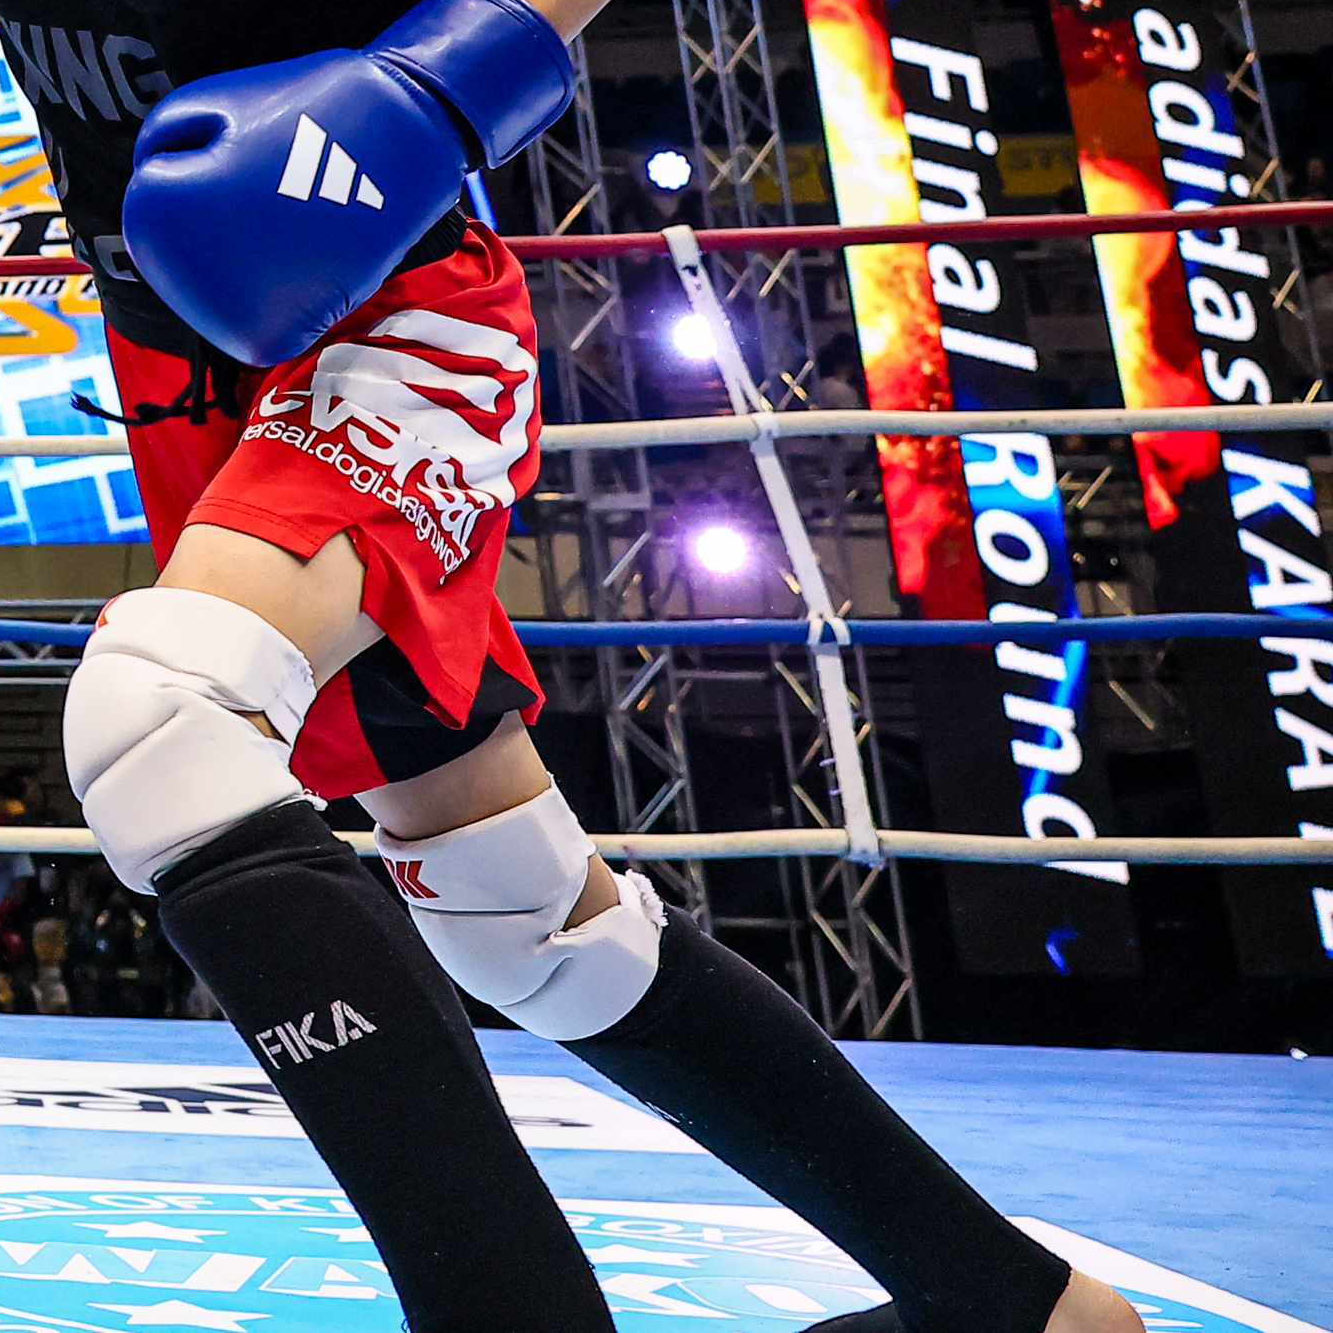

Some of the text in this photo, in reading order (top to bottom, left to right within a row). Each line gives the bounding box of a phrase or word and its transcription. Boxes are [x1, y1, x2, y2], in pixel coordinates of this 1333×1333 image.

[890, 35, 1040, 373] Final
[1134, 8, 1273, 406] adidas
[959, 433, 1131, 886] Round
[1221, 449, 1333, 959] KARA
[89, 1194, 215, 1210] OF
[254, 998, 379, 1070] FIKA
